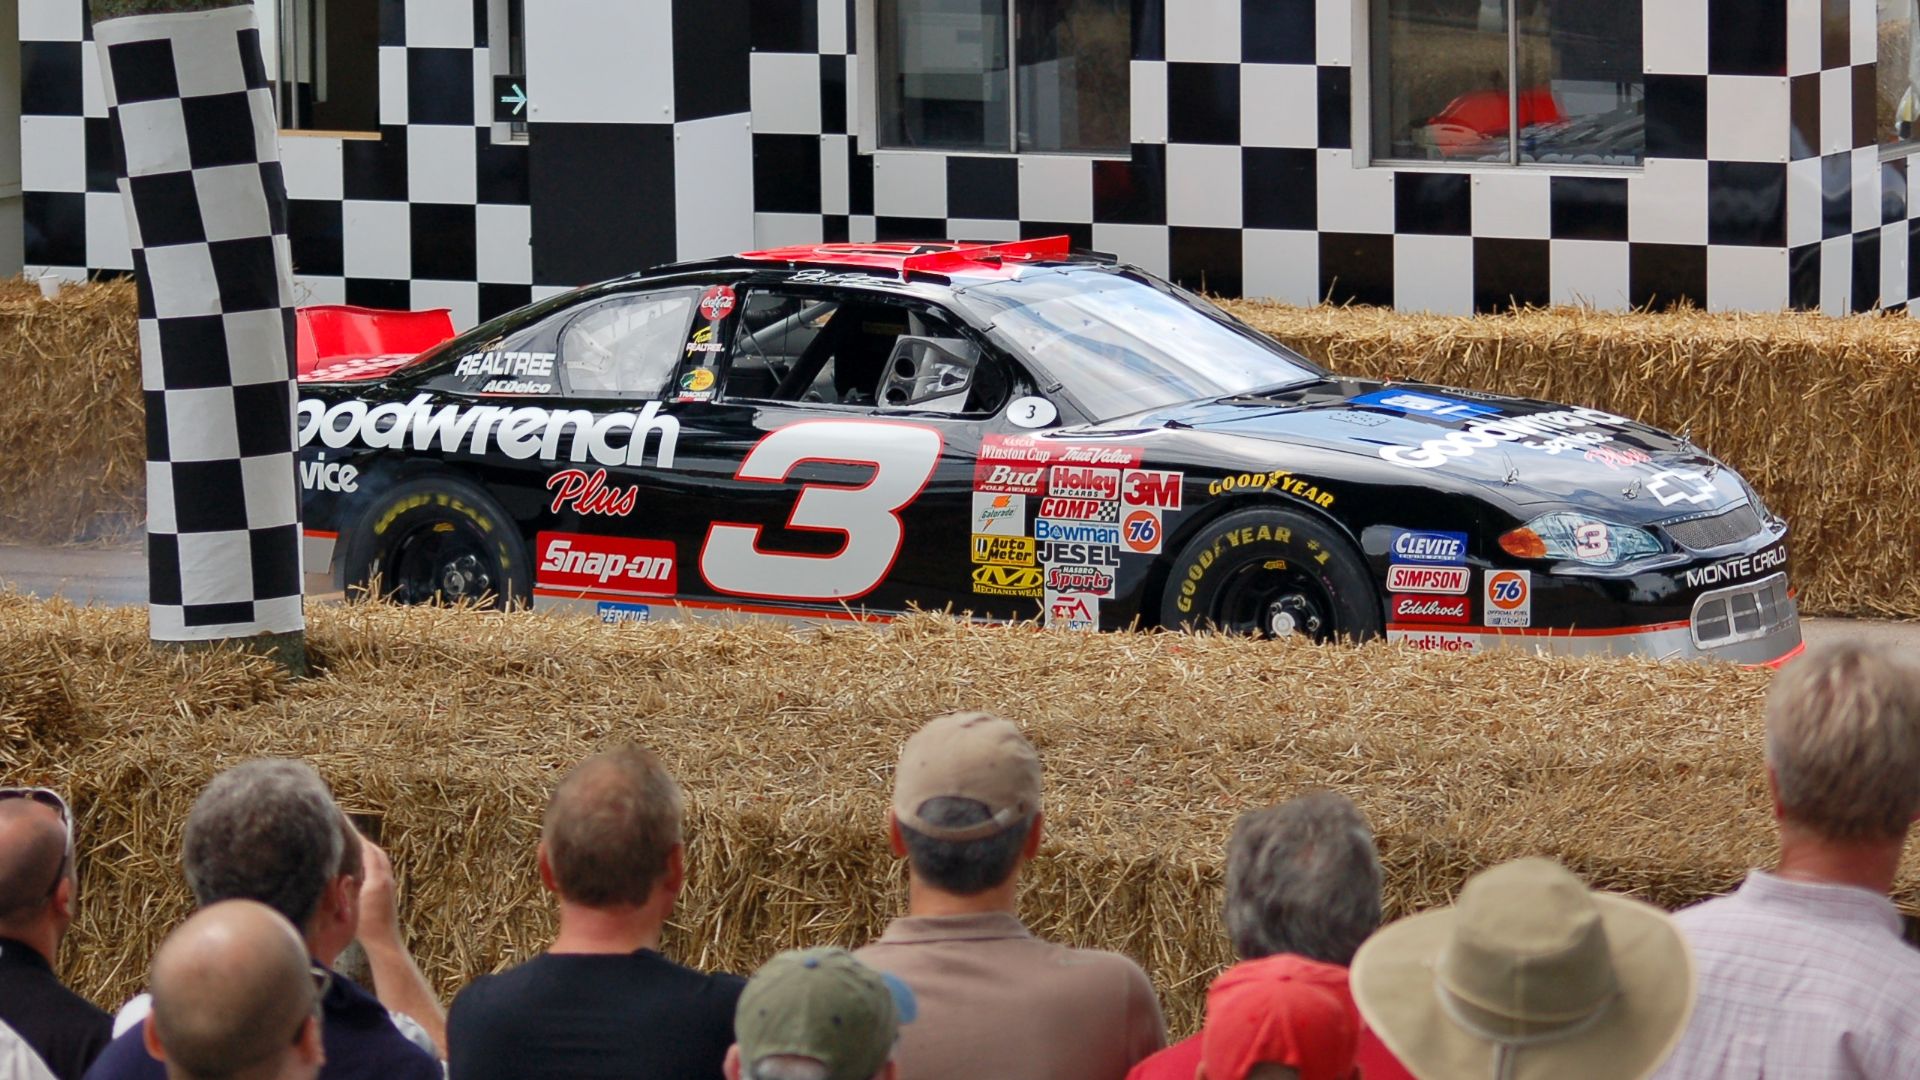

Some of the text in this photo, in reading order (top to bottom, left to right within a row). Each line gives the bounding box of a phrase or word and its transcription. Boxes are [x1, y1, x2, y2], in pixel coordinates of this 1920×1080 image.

[454, 352, 556, 377] REALTREE
[481, 380, 551, 394] ACDelco
[1026, 404, 1036, 419] 3
[297, 393, 680, 469] oodwrench
[982, 444, 1050, 463] Winston Cup
[300, 452, 359, 493] vice
[985, 465, 1044, 486] Bud
[1053, 467, 1117, 498] Holley
[546, 468, 639, 516] Plus
[1123, 471, 1181, 508] 3M
[698, 418, 944, 602] 3
[1040, 498, 1099, 519] COMP
[1036, 520, 1119, 544] Bowman
[1129, 519, 1155, 542] 76
[1575, 524, 1610, 558] 3
[990, 538, 1026, 550] Auto
[1037, 543, 1119, 566] JESEL
[1396, 532, 1460, 555] CLEVITE
[540, 539, 673, 583] Snap-on
[988, 549, 1032, 561] Meter
[1063, 566, 1094, 574] HASBRO
[1686, 545, 1787, 588] MONTE CARLO
[1047, 568, 1113, 590] Sports
[1394, 569, 1463, 589] SIMPSON
[973, 584, 1043, 597] MECHANIX WEAR
[1494, 580, 1521, 601] 76
[1397, 599, 1464, 617] Edelbrock
[1404, 634, 1473, 651] lasti-kote
